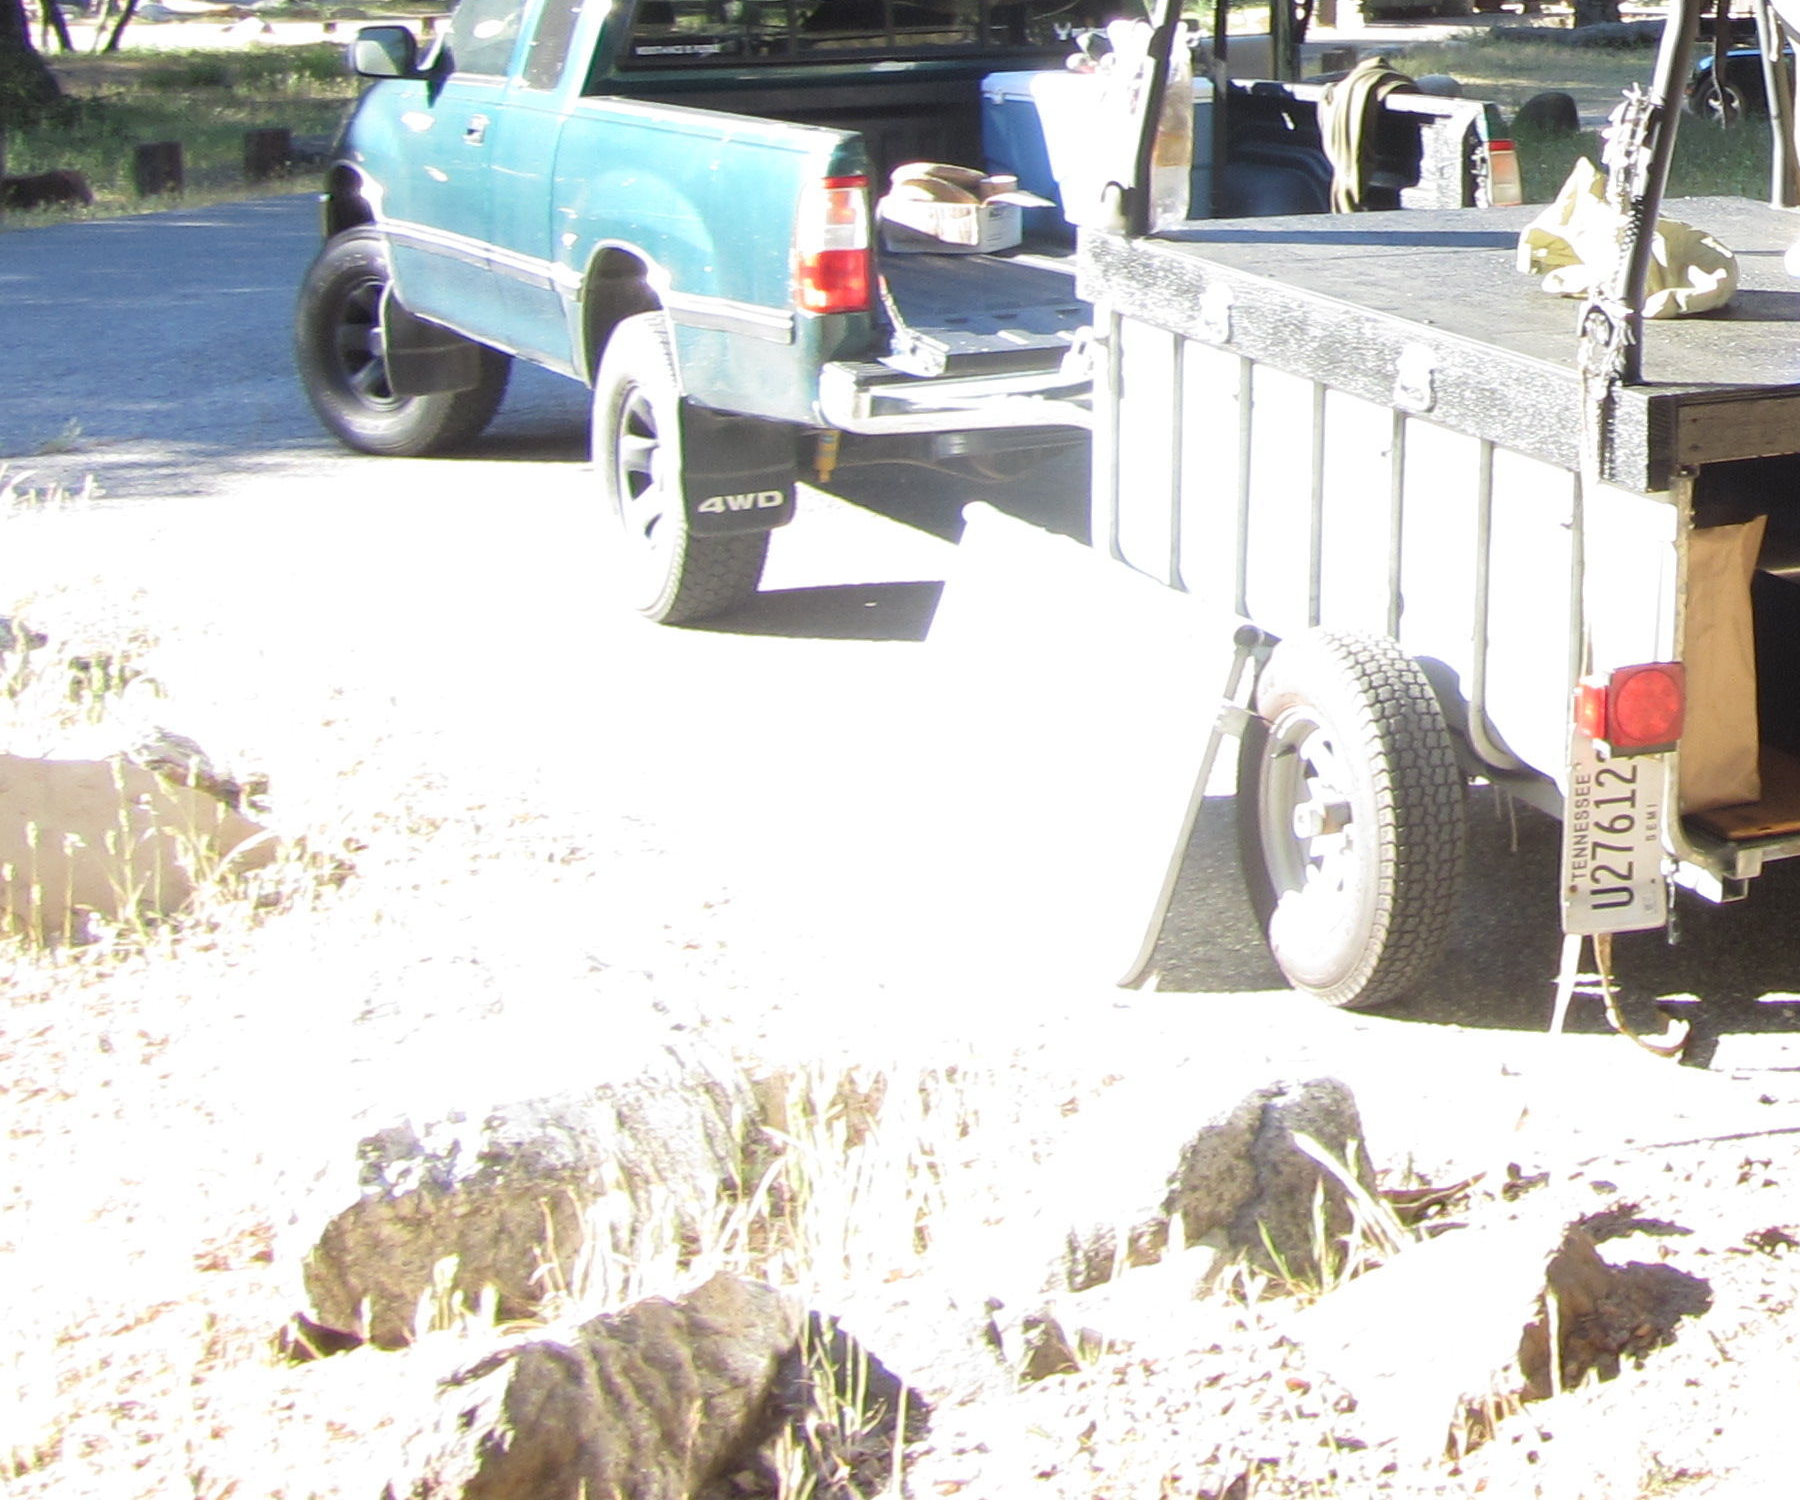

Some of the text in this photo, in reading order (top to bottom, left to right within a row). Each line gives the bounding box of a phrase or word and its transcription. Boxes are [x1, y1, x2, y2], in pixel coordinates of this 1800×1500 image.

[698, 490, 784, 513] 4WD
[1571, 773, 1591, 882] TENNESSEE
[1589, 750, 1638, 910] U27612
